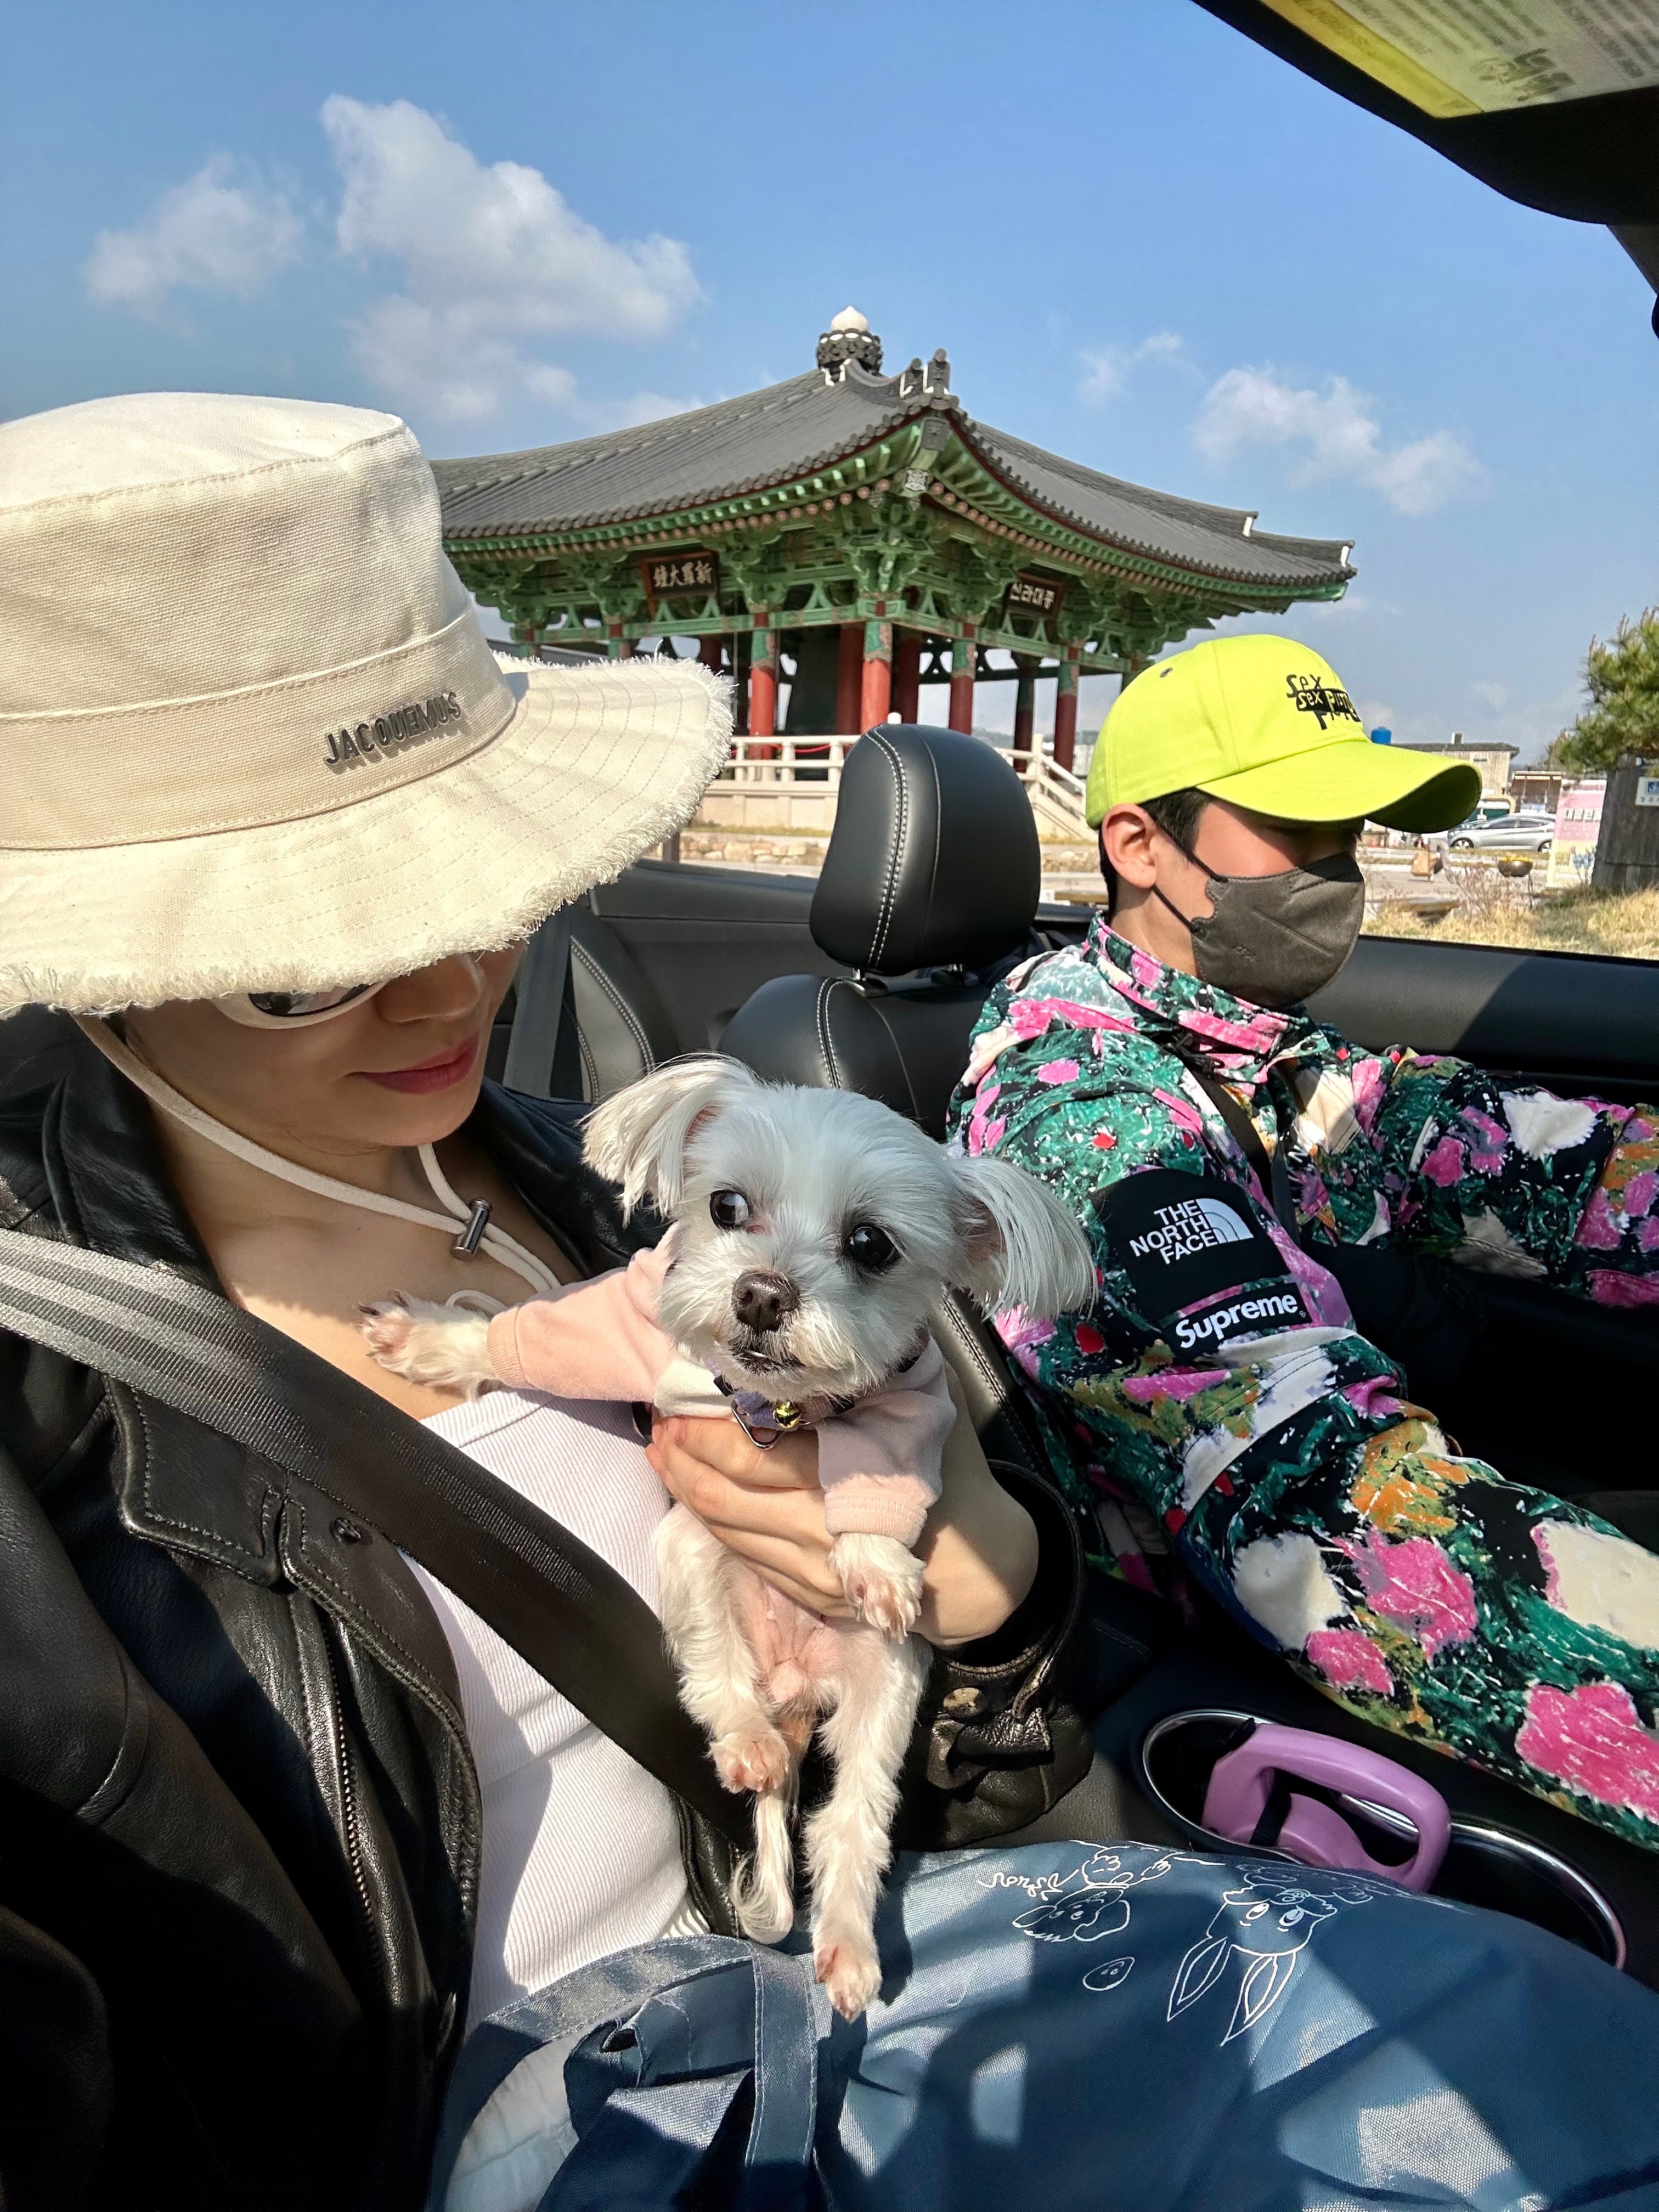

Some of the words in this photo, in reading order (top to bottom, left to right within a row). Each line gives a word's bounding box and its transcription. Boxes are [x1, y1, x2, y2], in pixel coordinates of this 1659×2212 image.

[1009, 582, 1055, 610] 신라대종
[325, 692, 461, 764] JACQUEMUS
[1154, 1199, 1203, 1225] THE
[1129, 1214, 1209, 1257] NORTH
[1159, 1230, 1218, 1265] FACE
[1176, 1294, 1298, 1348] Supreme
